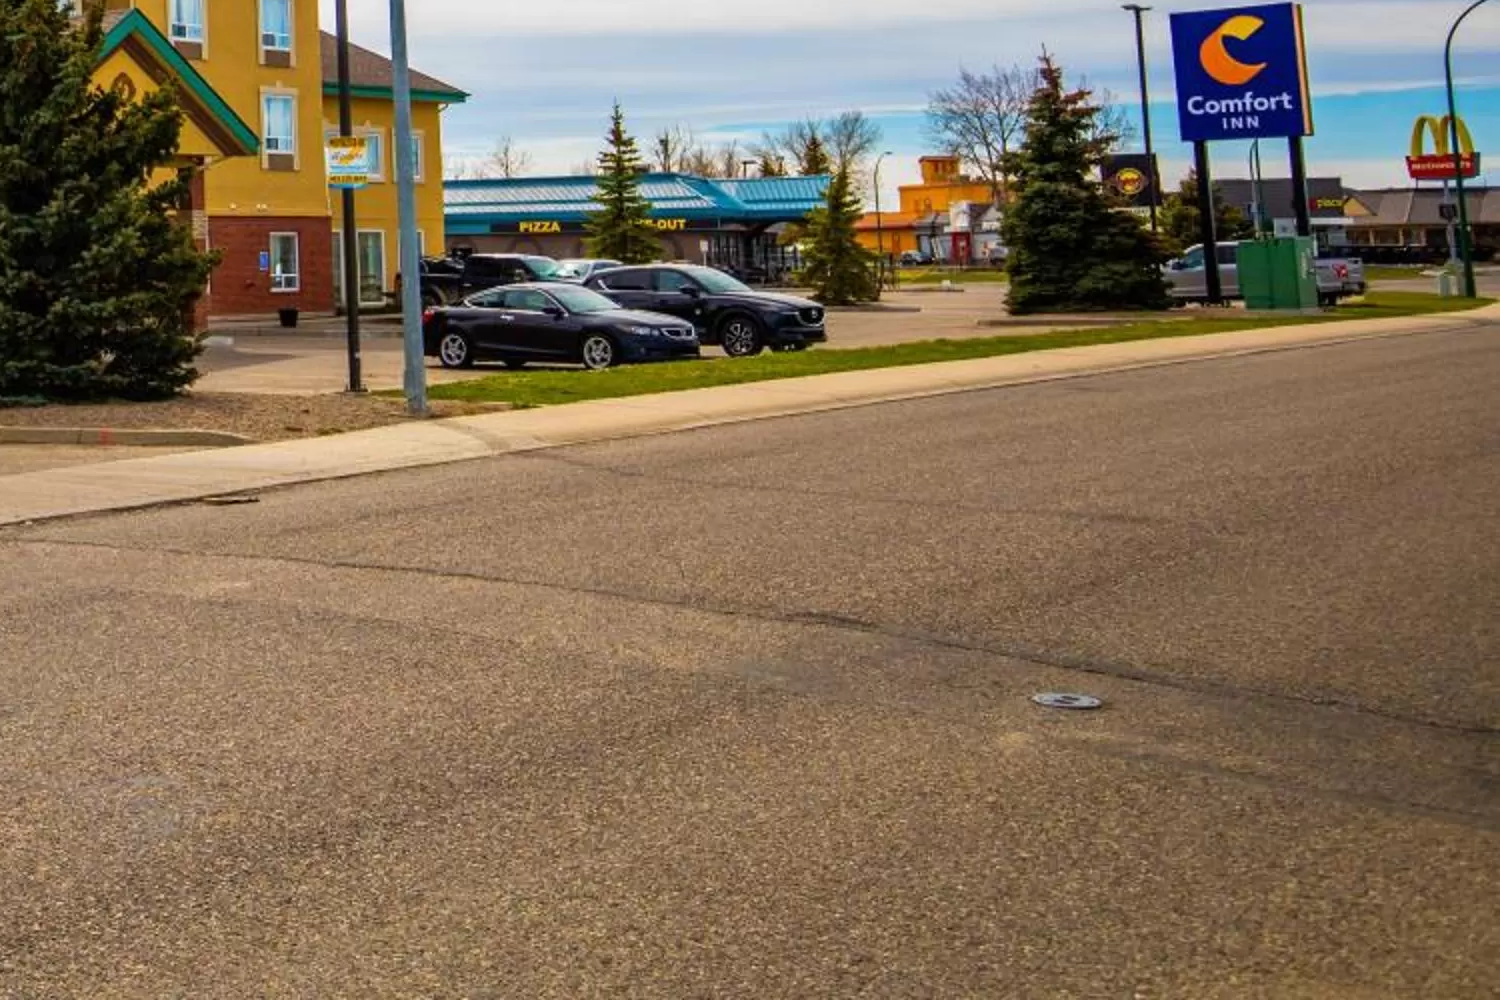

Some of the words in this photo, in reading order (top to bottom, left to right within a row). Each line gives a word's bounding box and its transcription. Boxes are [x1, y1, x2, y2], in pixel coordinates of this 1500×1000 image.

[1187, 91, 1293, 115] Comfort
[1222, 116, 1259, 130] INN
[519, 221, 561, 233] PIZZA
